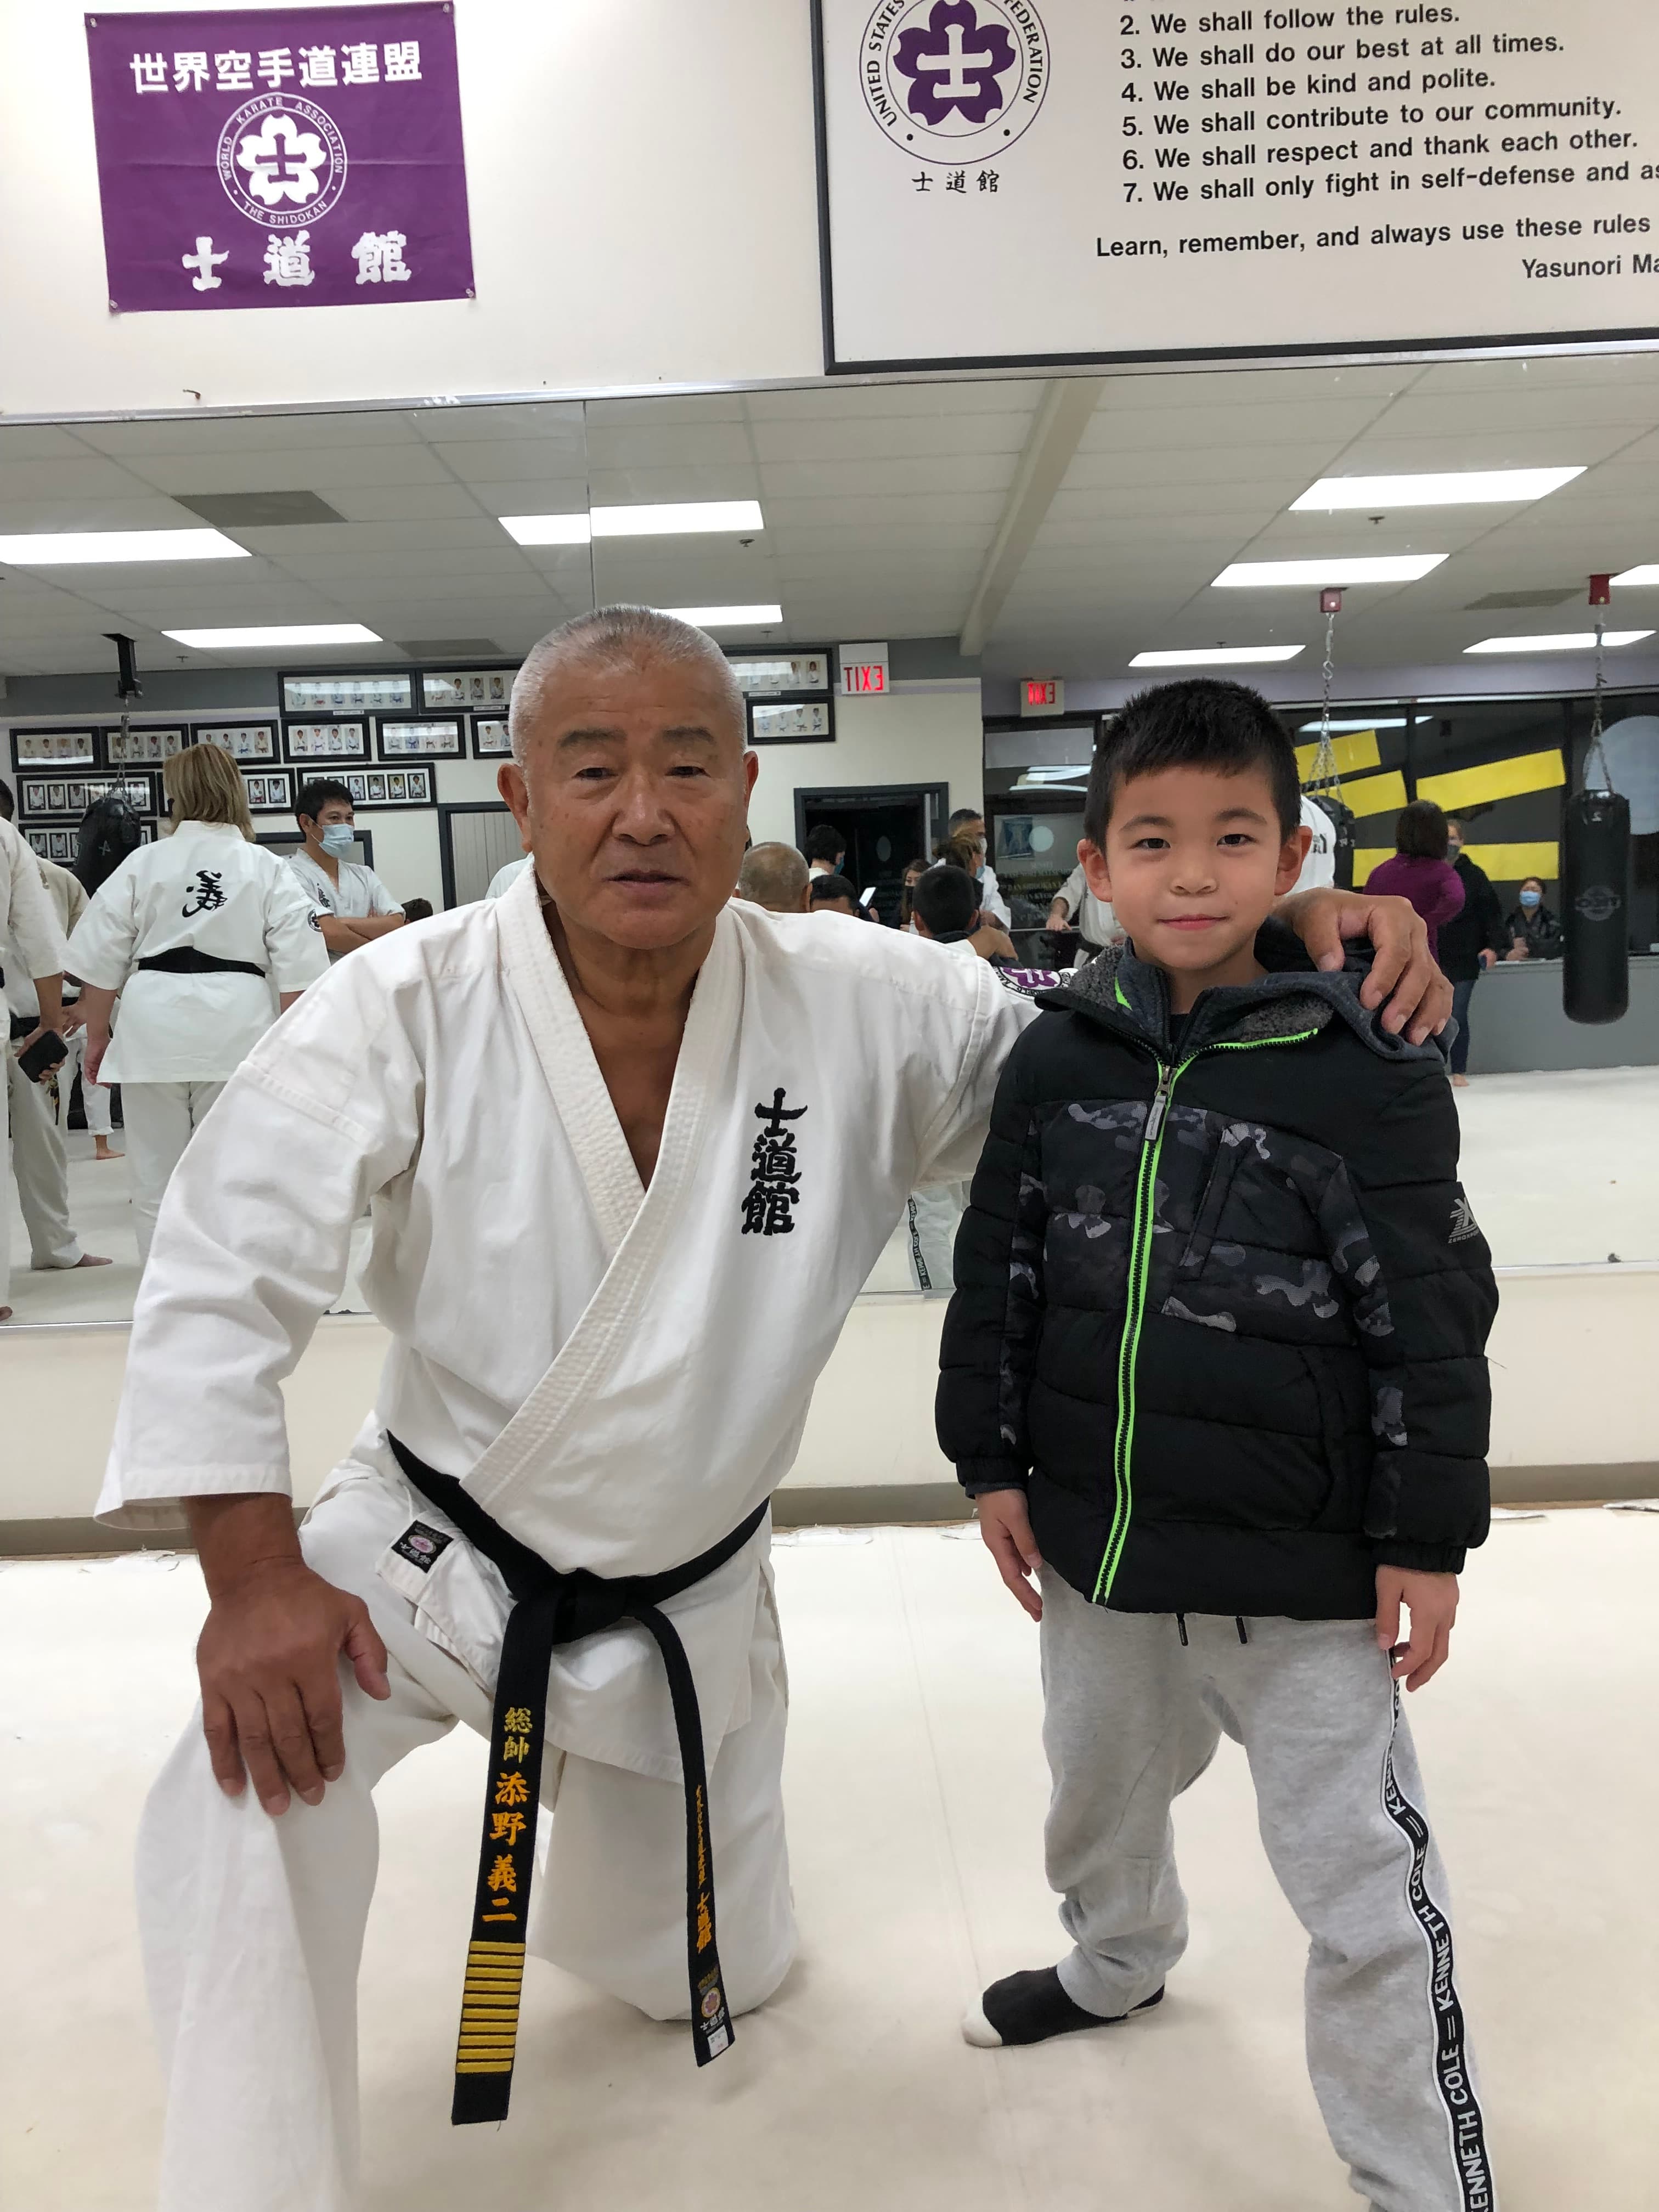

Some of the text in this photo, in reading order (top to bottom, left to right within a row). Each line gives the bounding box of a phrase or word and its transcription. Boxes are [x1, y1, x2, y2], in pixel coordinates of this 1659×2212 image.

[1120, 3, 1459, 36] 2. We shall follow the rules.
[129, 40, 422, 94] 世界空手道連盟
[1120, 33, 1564, 69] 3. We shall do our best at all times.
[867, 60, 898, 127] UNITED
[1121, 67, 1495, 103] 4. We shall be kind and polite.
[1121, 96, 1621, 137] 5. We shall contribute to our community.
[221, 97, 343, 180] WORLD KARATE ASSOCIATION
[1122, 128, 1638, 170] 6. We shall respect and thank each other.
[912, 170, 1000, 194] 士道館
[1123, 182, 1143, 203] 7.
[1153, 180, 1189, 201] We
[1200, 177, 1254, 200] shall
[1265, 174, 1314, 199] only
[1325, 172, 1380, 198] fight
[1390, 170, 1410, 190] in
[1421, 165, 1575, 189] self-defense
[1586, 160, 1629, 182] and
[243, 200, 328, 224] THE SHIDOKAN
[1096, 213, 1651, 258] Learn, remember, and always use these rules
[182, 230, 412, 292] 士道館
[1521, 255, 1621, 279] Yasunori
[741, 1087, 808, 1236] 士道館
[1410, 1842, 1454, 2012] KENNETH COLE
[1441, 2044, 1489, 2212] ENNETH COLE
